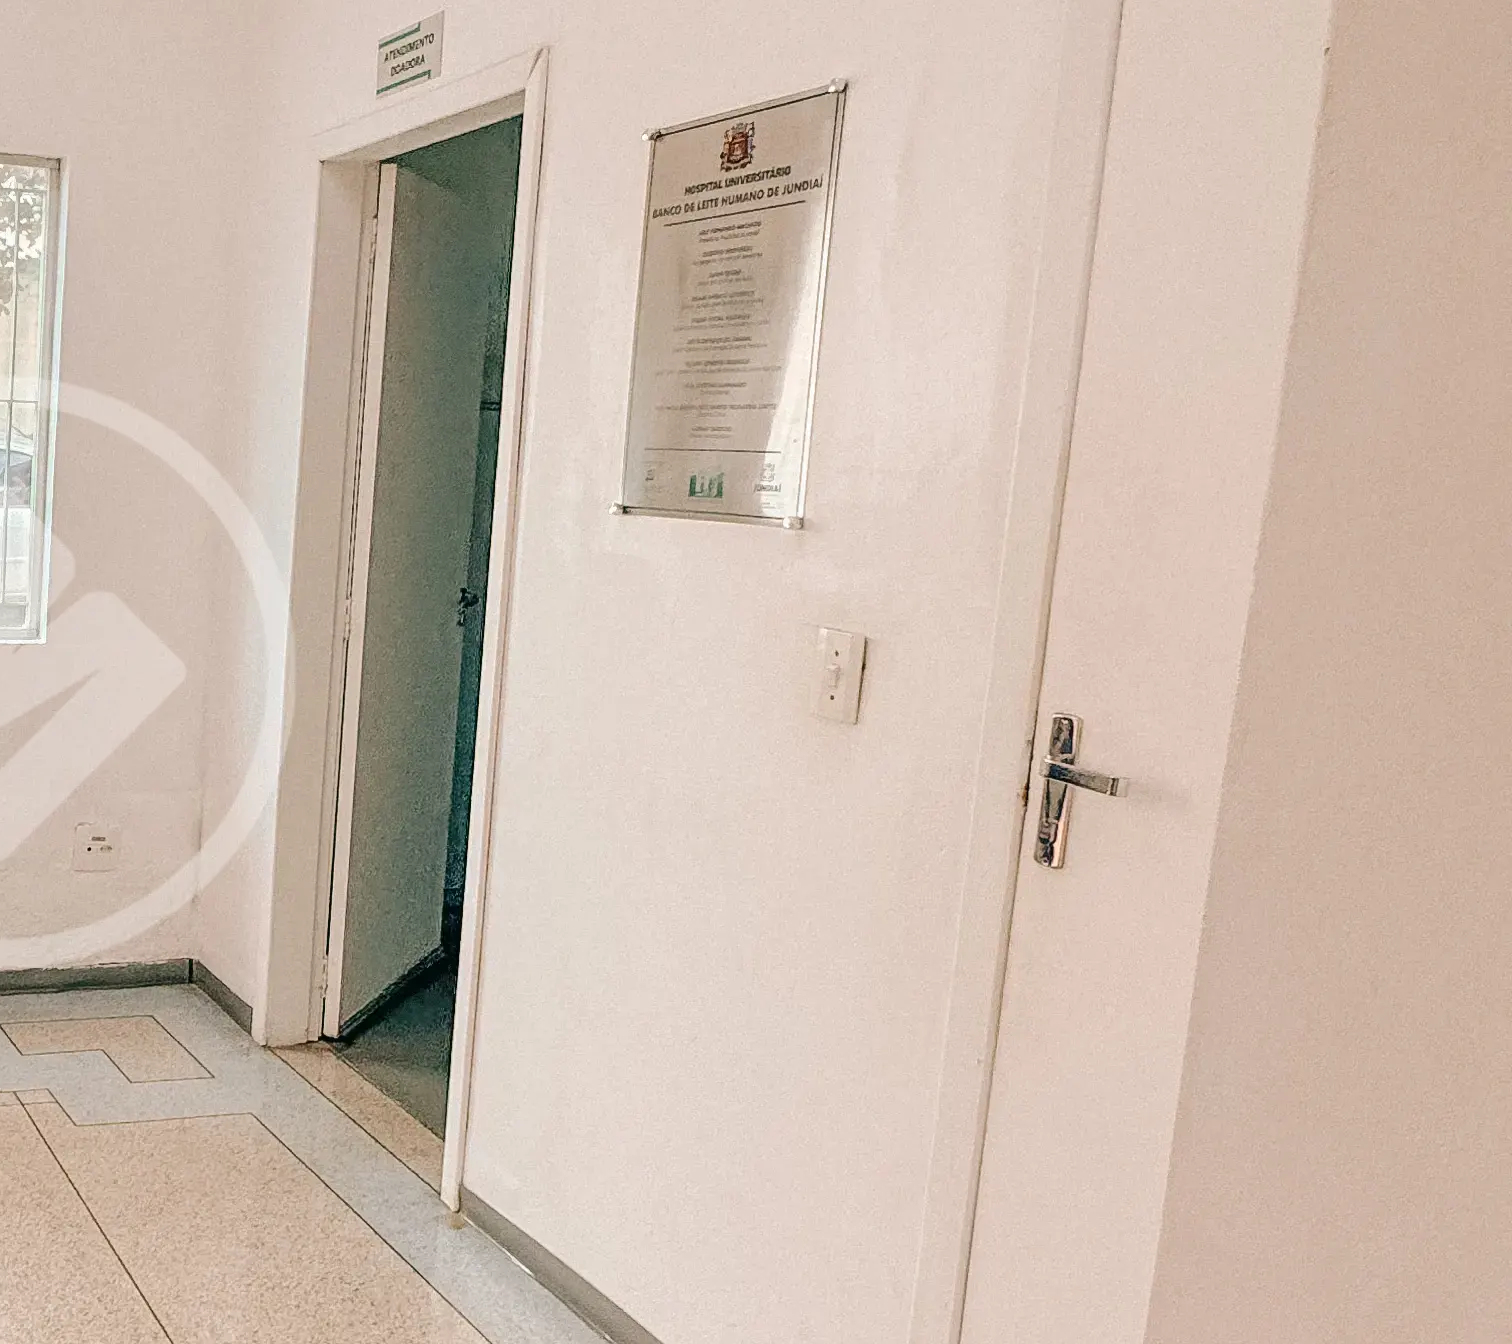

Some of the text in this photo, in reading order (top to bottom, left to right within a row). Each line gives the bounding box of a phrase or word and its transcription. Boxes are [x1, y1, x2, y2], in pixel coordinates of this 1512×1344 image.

[652, 174, 823, 219] BANCO DE LEITE HUMANO DE JUNDIAÍ
[684, 181, 723, 196] HOSPITAL
